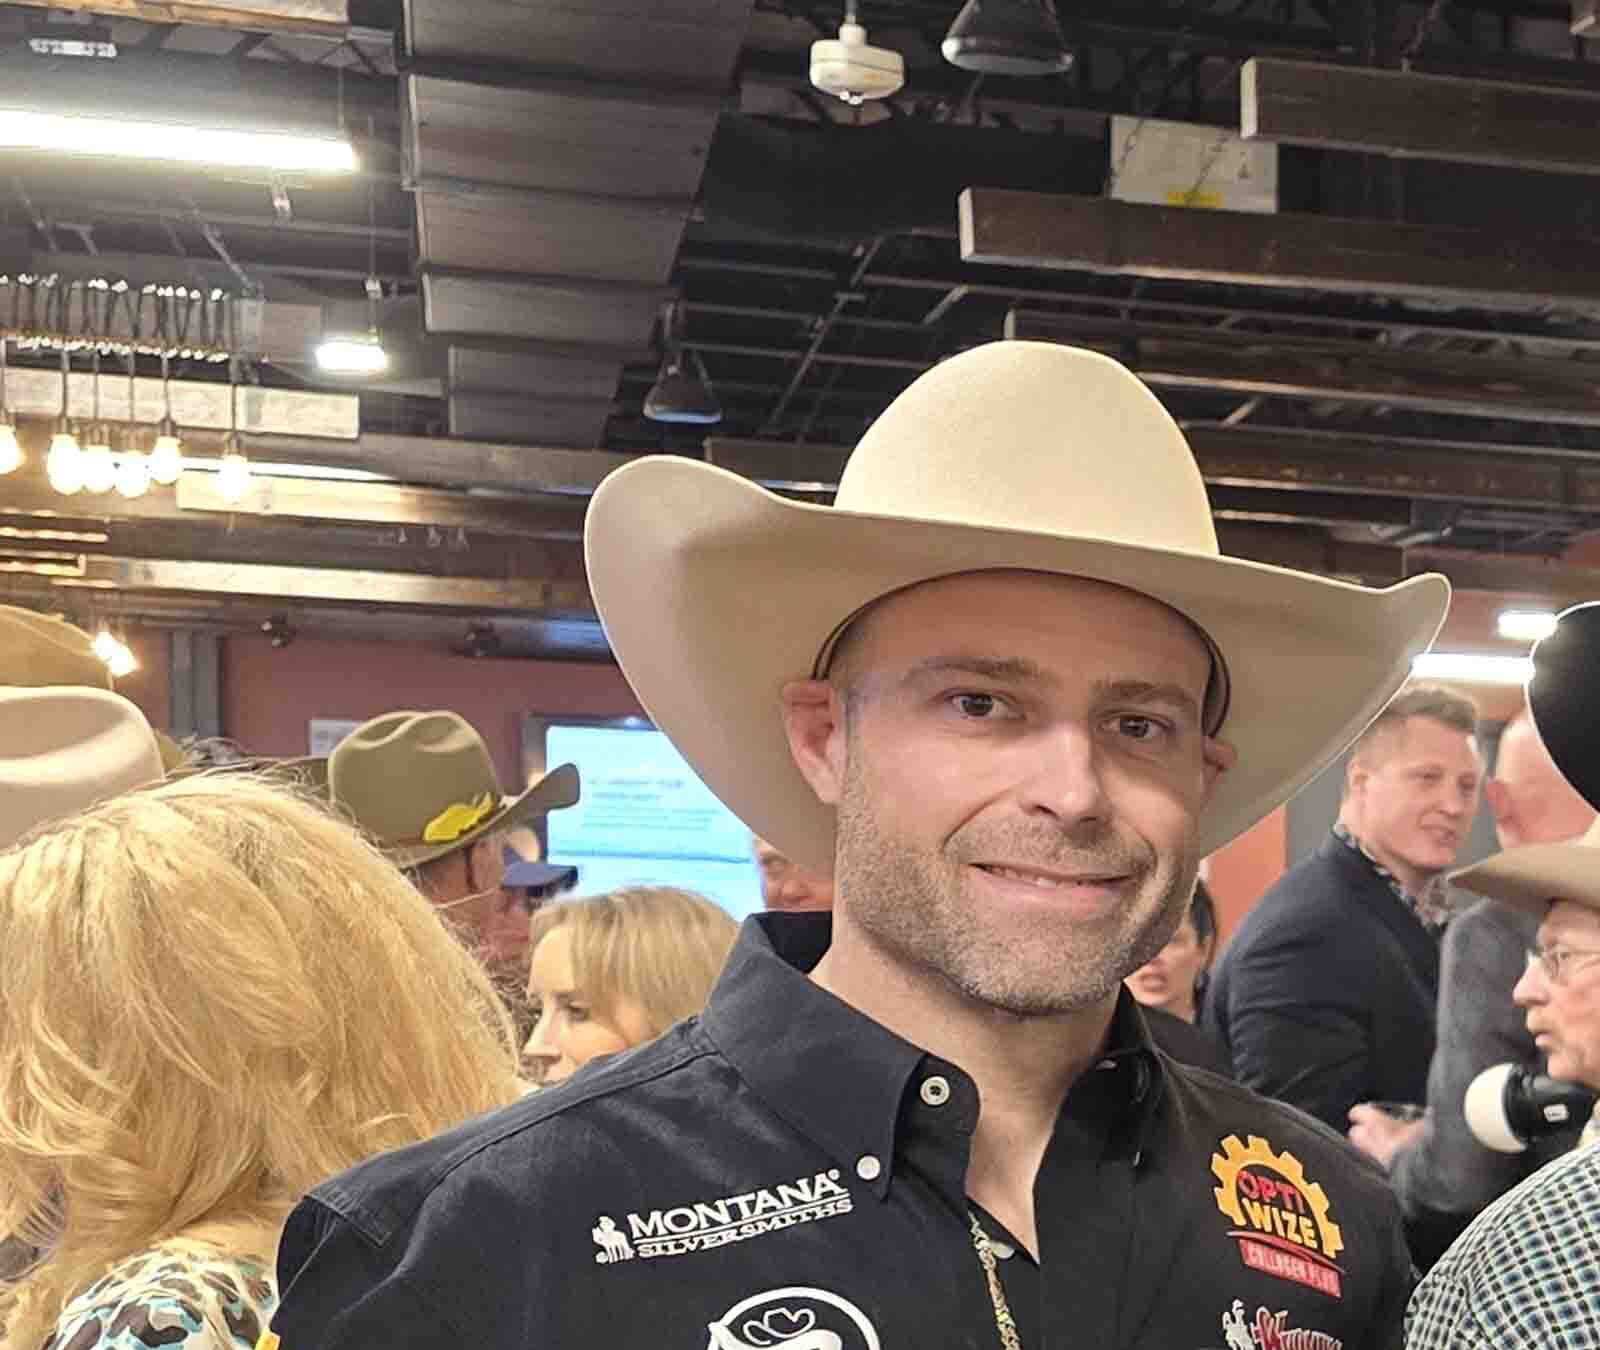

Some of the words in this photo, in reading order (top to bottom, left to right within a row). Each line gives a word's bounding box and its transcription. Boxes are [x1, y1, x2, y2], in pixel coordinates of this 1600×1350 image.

[627, 1170, 849, 1239] MONTANA
[1237, 1170, 1305, 1214] OPTI
[637, 1198, 853, 1259] SILVERSMITHS
[1242, 1197, 1318, 1249] WIZE
